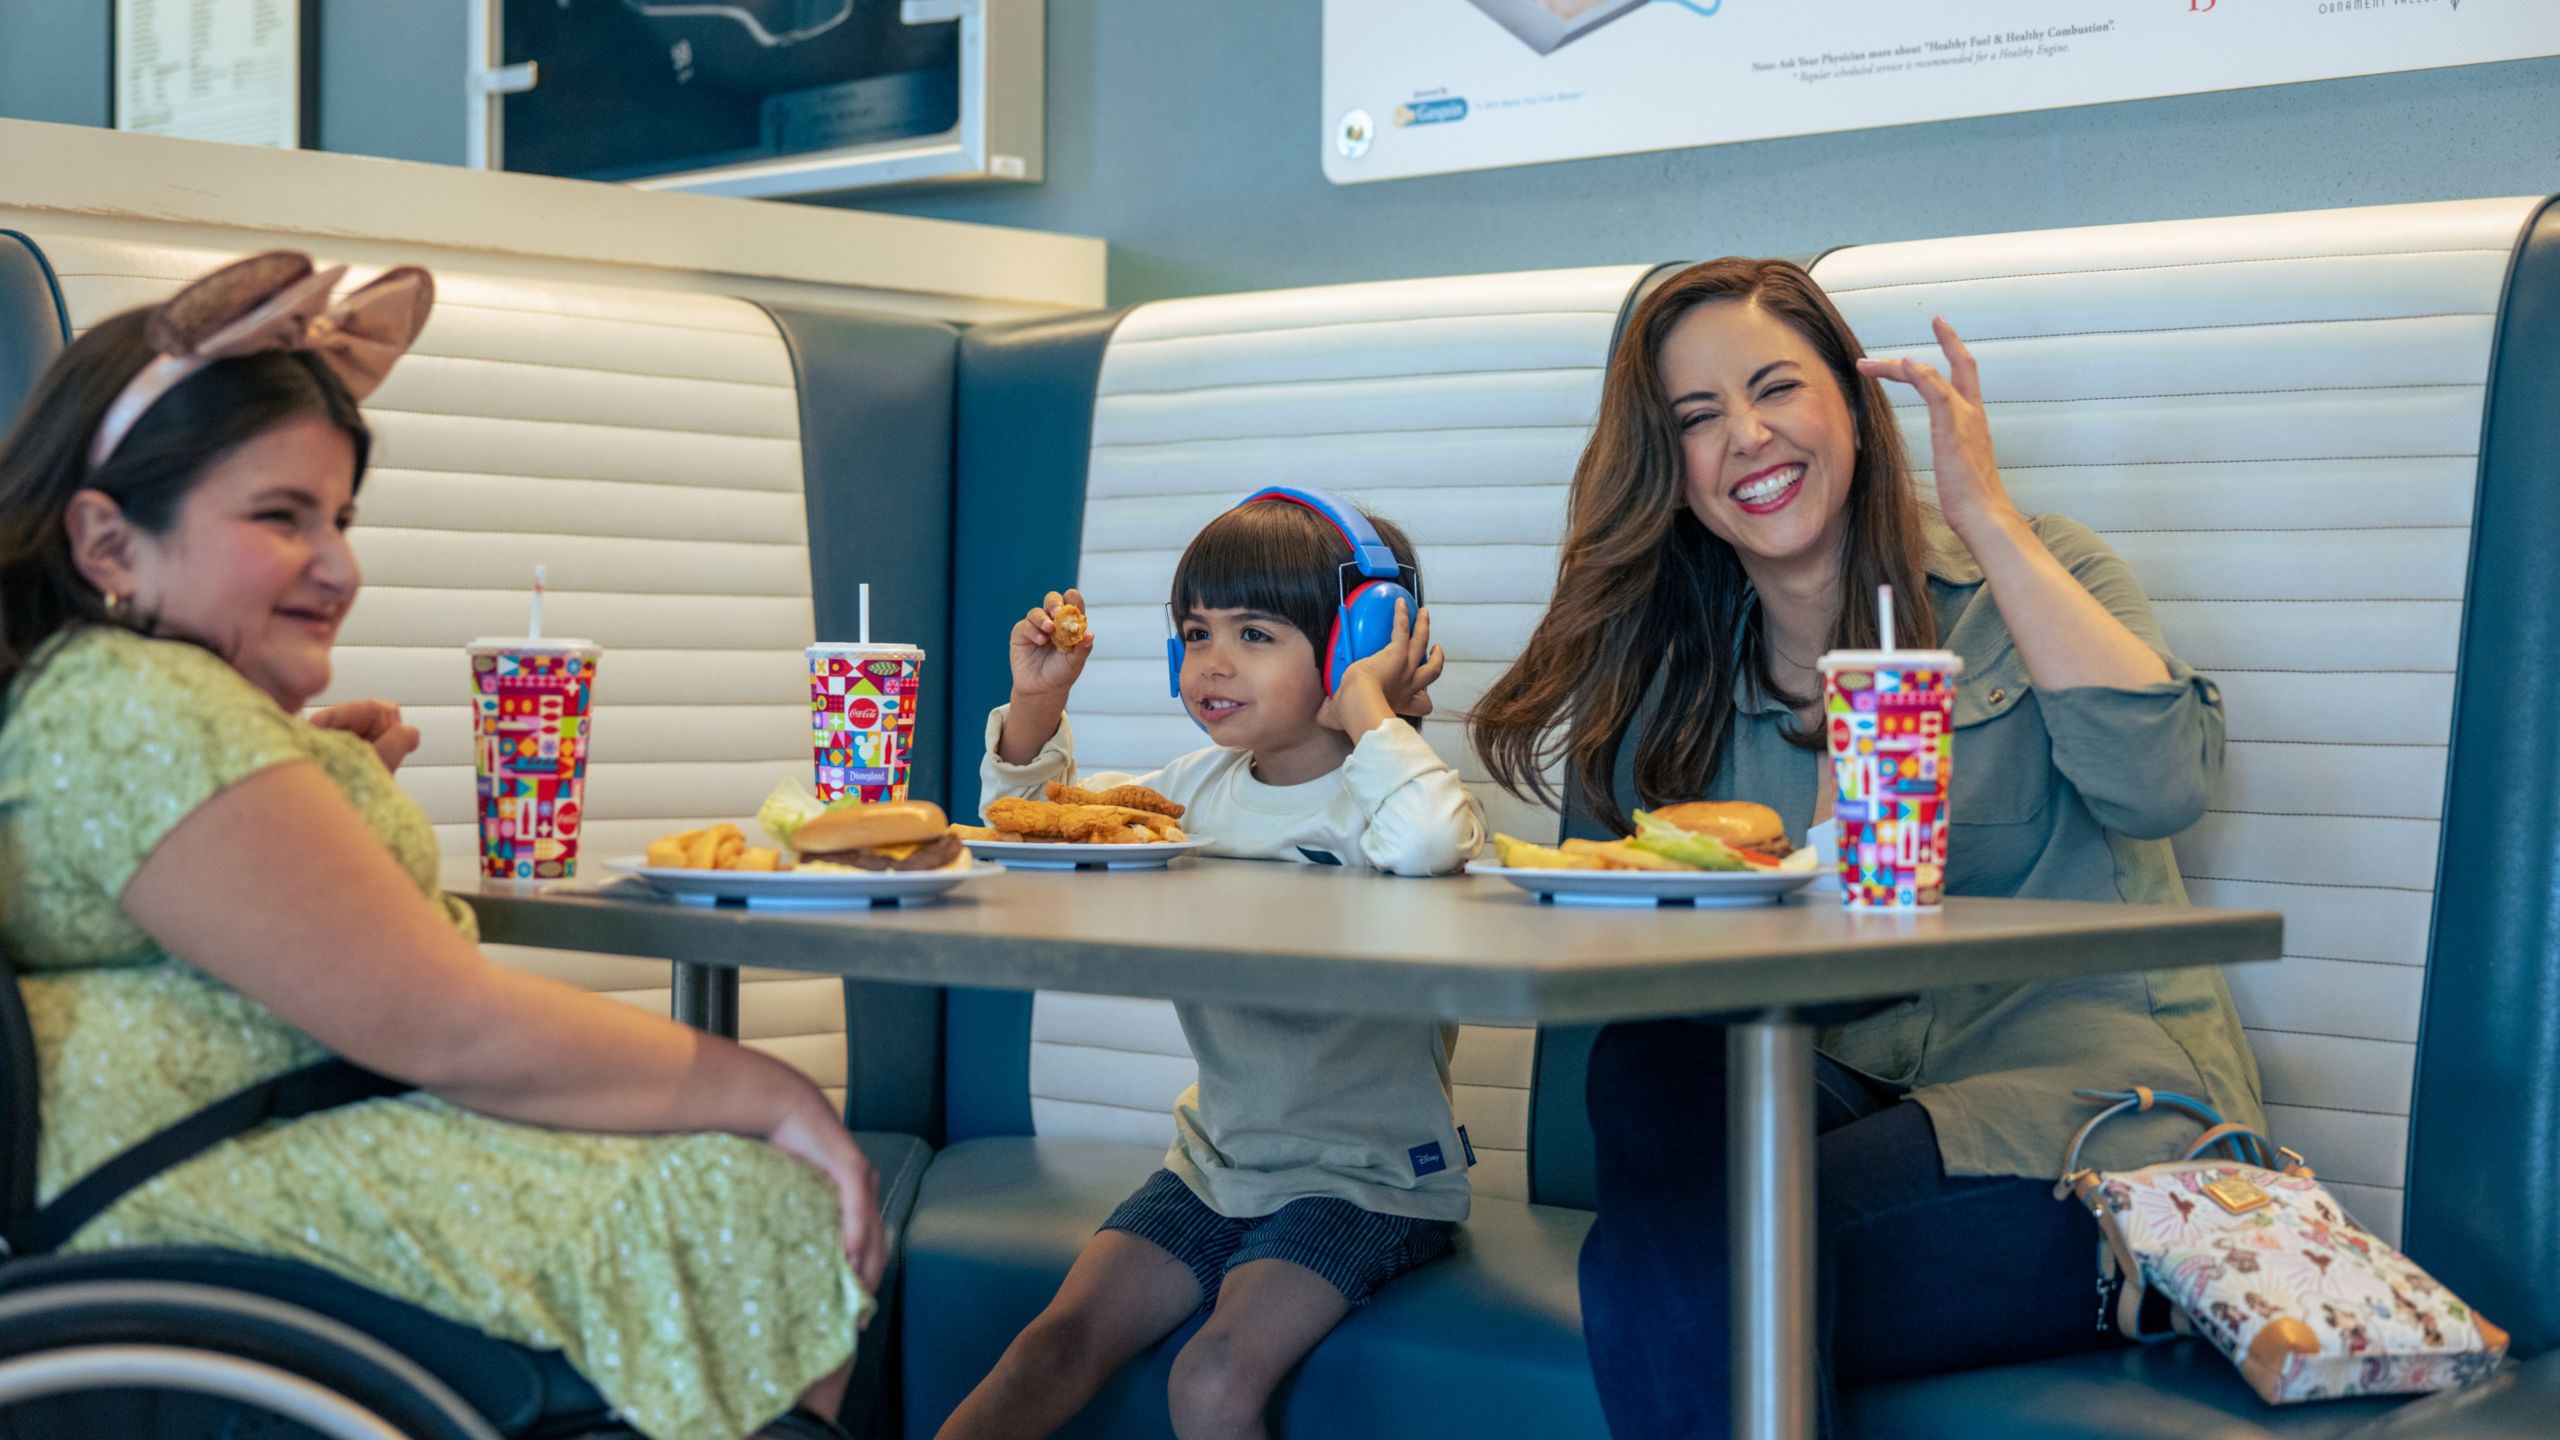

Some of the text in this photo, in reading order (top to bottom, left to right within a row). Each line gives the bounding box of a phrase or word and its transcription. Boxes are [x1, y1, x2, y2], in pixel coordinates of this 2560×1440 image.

[2318, 0, 2385, 14] ORNAMENT
[1779, 58, 1796, 70] Ask
[1798, 56, 1819, 68] Your
[1821, 52, 1866, 66] Physician
[1868, 50, 1892, 60] more
[1894, 45, 1922, 56] about
[1970, 34, 1991, 48] Fuel
[1993, 33, 2003, 45] &
[2006, 29, 2045, 44] Healthy
[1833, 64, 1874, 79] scheduled
[1875, 61, 1904, 73] service
[1905, 61, 1912, 69] is
[1914, 51, 1973, 68] recommended
[1975, 50, 1989, 66] for
[1990, 53, 1997, 61] a
[1998, 44, 2035, 60] Healthy
[2036, 42, 2070, 57] Engine.
[849, 770, 884, 783] Disneyland
[1415, 1153, 1440, 1165] Disney
